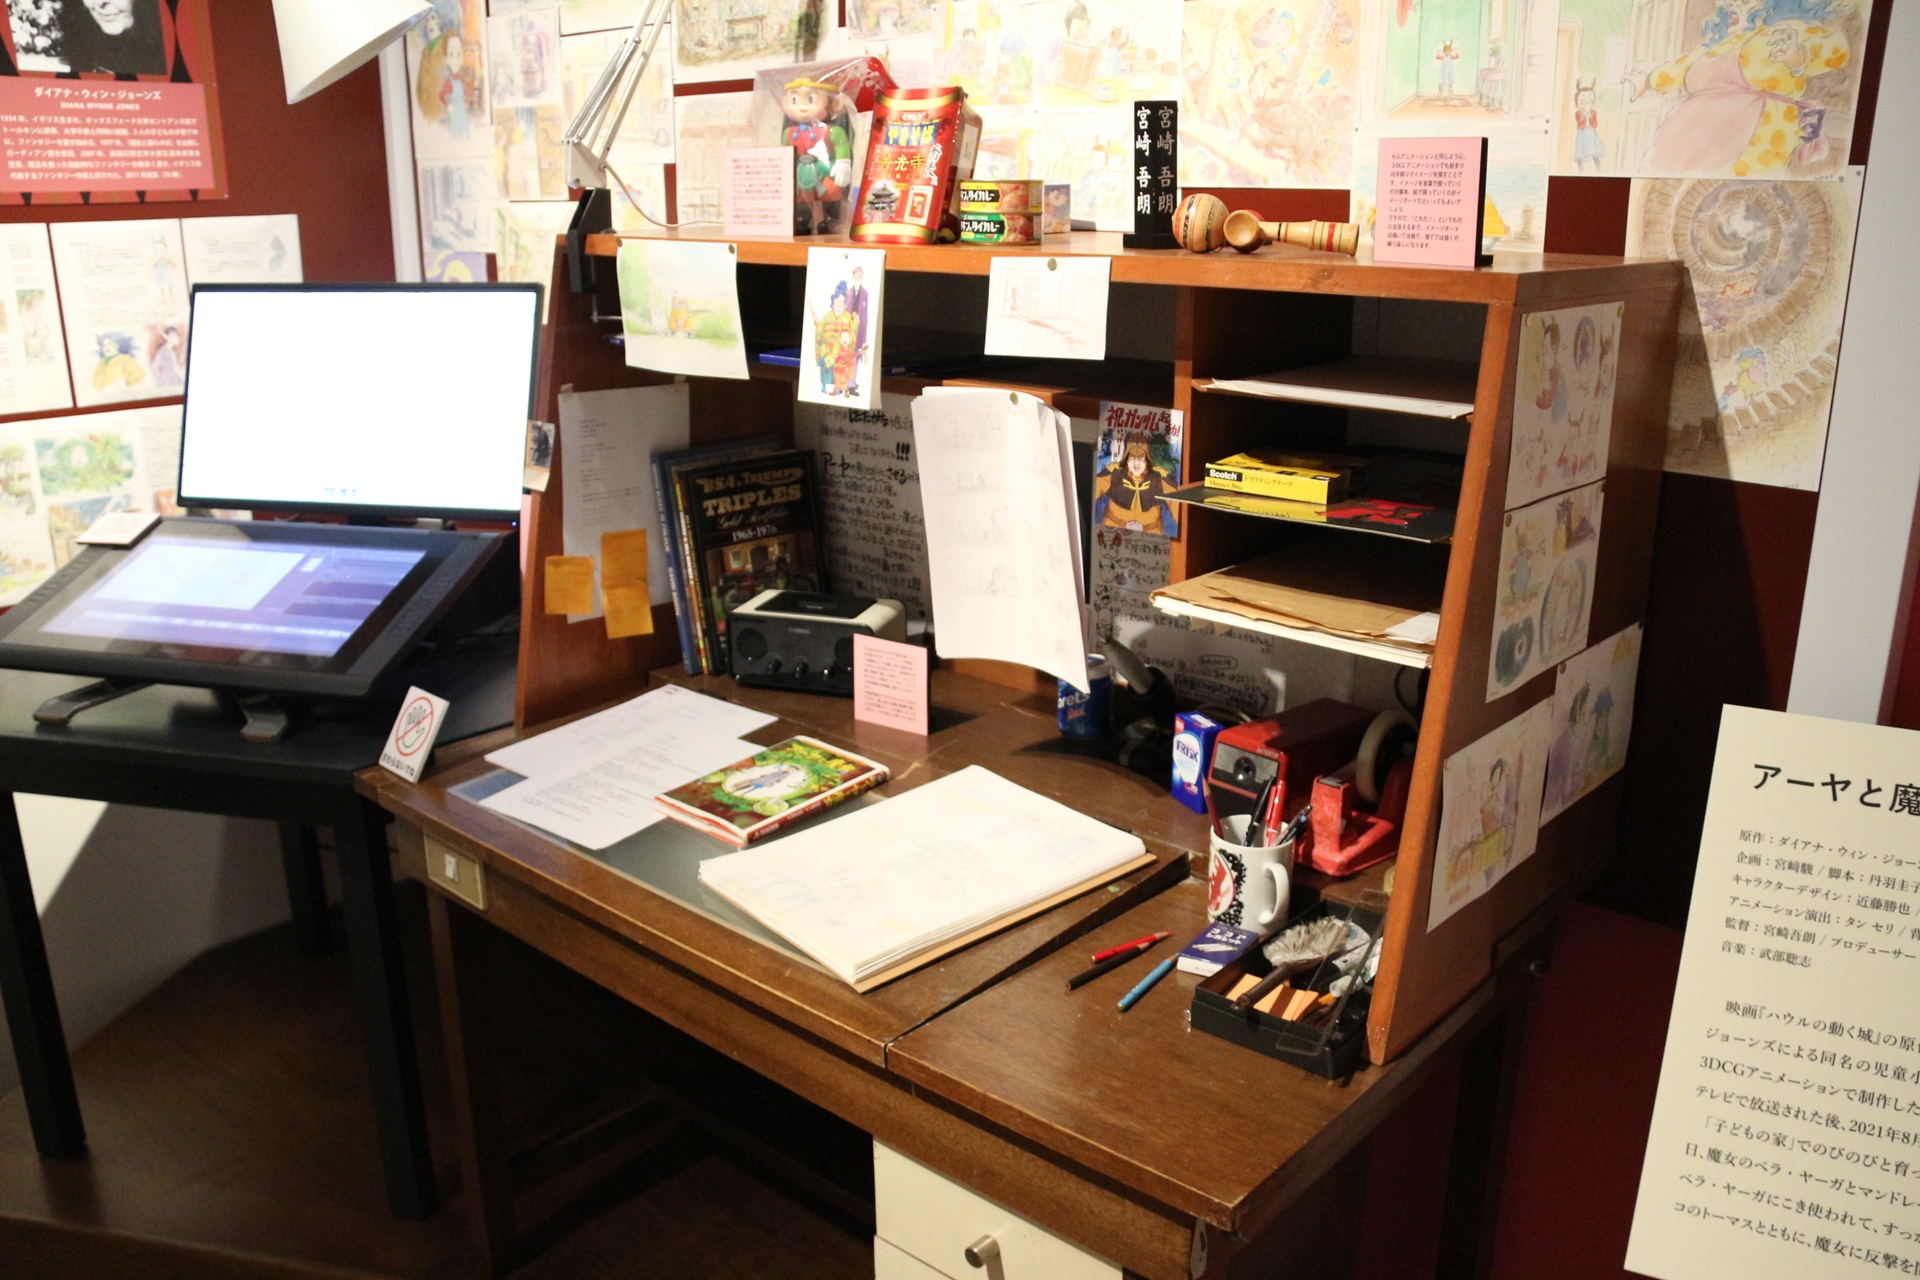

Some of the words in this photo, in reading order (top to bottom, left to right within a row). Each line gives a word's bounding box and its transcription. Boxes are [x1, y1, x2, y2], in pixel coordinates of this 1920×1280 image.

[34, 86, 162, 100] ダイアナ・ウィン・ジョーンズ
[60, 101, 86, 109] DIANA
[887, 124, 935, 146] やきそば
[878, 153, 926, 171] 善光寺
[1209, 469, 1238, 480] Scotch
[1245, 475, 1293, 488] ドラフティングテープ
[703, 484, 802, 517] TRIPLES
[732, 525, 778, 541] 1968-1976
[1177, 740, 1199, 763] FRISK
[382, 753, 415, 777] さわらないでね
[1753, 763, 1920, 817] アーヤと魔
[1738, 829, 1920, 869] 原作：ダイアナ・ウィン・ジョー
[1211, 928, 1247, 940] ココア
[1725, 1000, 1920, 1052] 映画『ハウルの動く城』の原
[1685, 1142, 1920, 1207] 日、魔女のベラ・ヤーガとマンドレ
